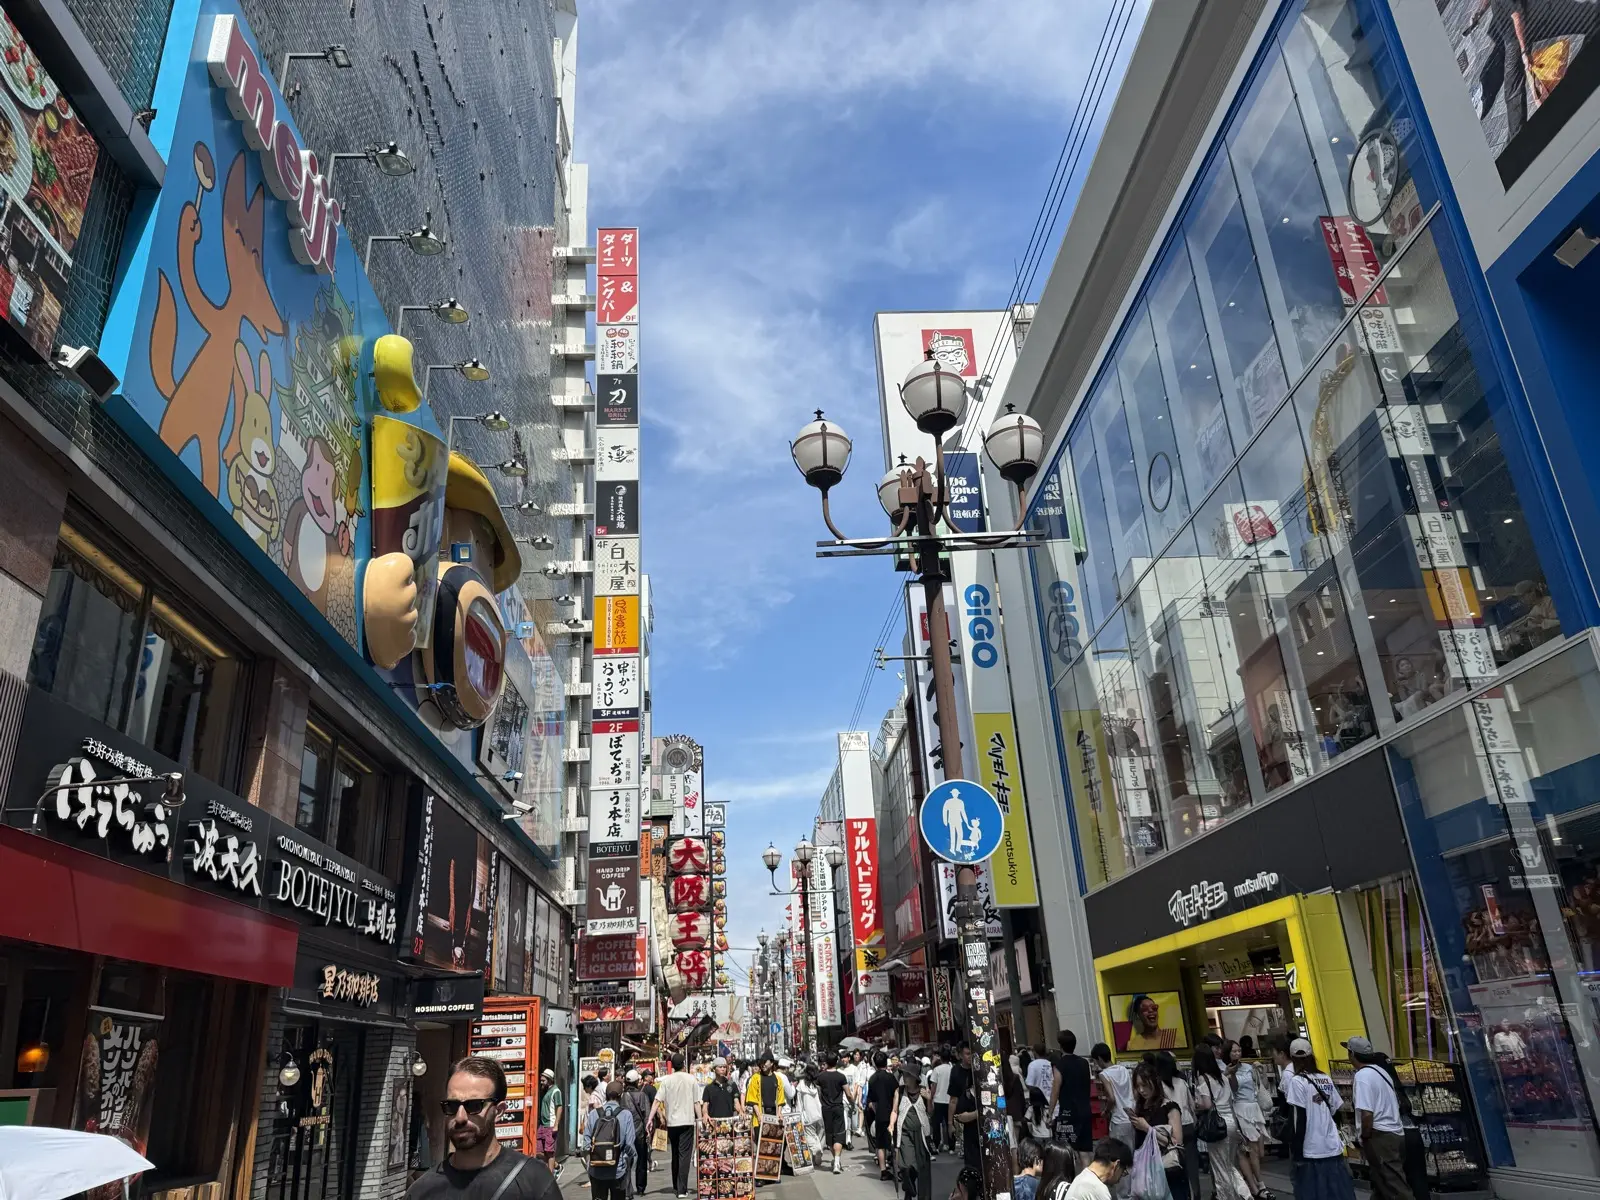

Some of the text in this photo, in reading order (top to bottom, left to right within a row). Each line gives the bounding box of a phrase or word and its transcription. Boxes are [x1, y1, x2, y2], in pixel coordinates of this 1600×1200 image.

[210, 14, 341, 278] meiji
[620, 233, 634, 293] ダーツ &
[602, 233, 616, 323] ダイニングバー
[950, 486, 979, 495] tone
[951, 494, 968, 503] Za
[596, 540, 608, 549] 4F
[609, 543, 636, 591] 白木屋
[602, 662, 615, 707] おうじ
[617, 661, 630, 695] 串かつ
[600, 709, 611, 717] 3F
[609, 723, 624, 733] 2F
[57, 758, 172, 853] ぼてぢゅう
[596, 845, 632, 854] BOTEJYU
[277, 835, 357, 884] OKONOMIYAKI TEPPANYAKI
[1003, 830, 1018, 886] matsukiyo
[601, 872, 626, 880] COFFEE
[852, 821, 877, 929] ツルハドラッグ
[1234, 871, 1280, 898] matsukiyo
[608, 897, 619, 909] H
[625, 906, 635, 915] 1F
[672, 838, 710, 989] 大阪王将
[589, 918, 636, 930] 星乃珈琲店
[596, 940, 637, 950] COFFEE
[965, 943, 987, 957] TROJAN
[591, 950, 642, 962] MILK TEA
[967, 955, 988, 968] NIMBUS
[588, 961, 644, 974] ICE CREAM
[322, 964, 380, 1008] 星乃珈琲店
[415, 1003, 475, 1013] HOSHINO COFFEE
